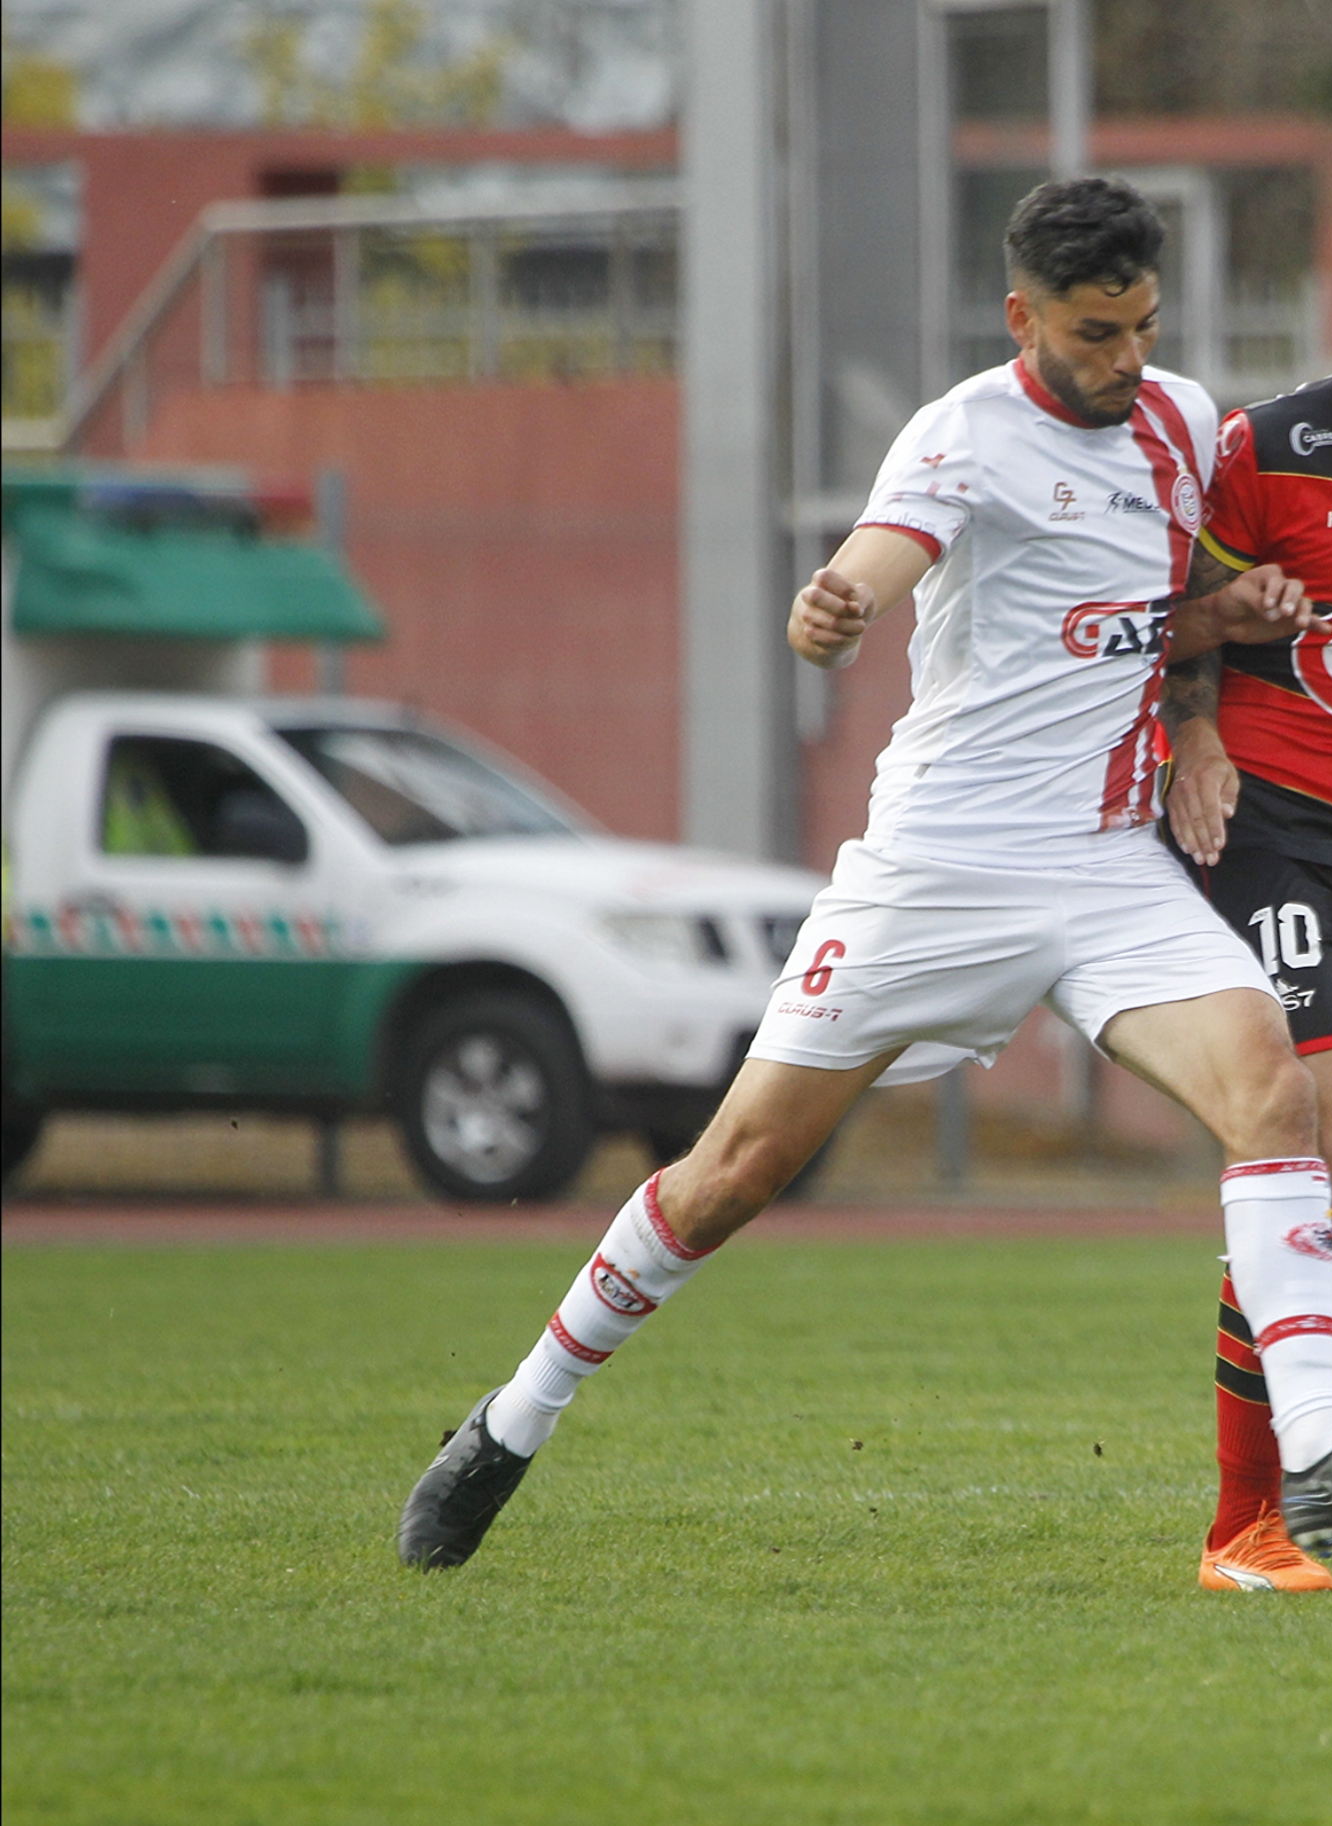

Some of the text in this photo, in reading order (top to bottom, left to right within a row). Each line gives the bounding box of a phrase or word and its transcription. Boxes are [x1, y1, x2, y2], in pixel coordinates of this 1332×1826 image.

[800, 938, 848, 998] 6
[1248, 901, 1323, 976] 10
[1281, 989, 1316, 1012] S7
